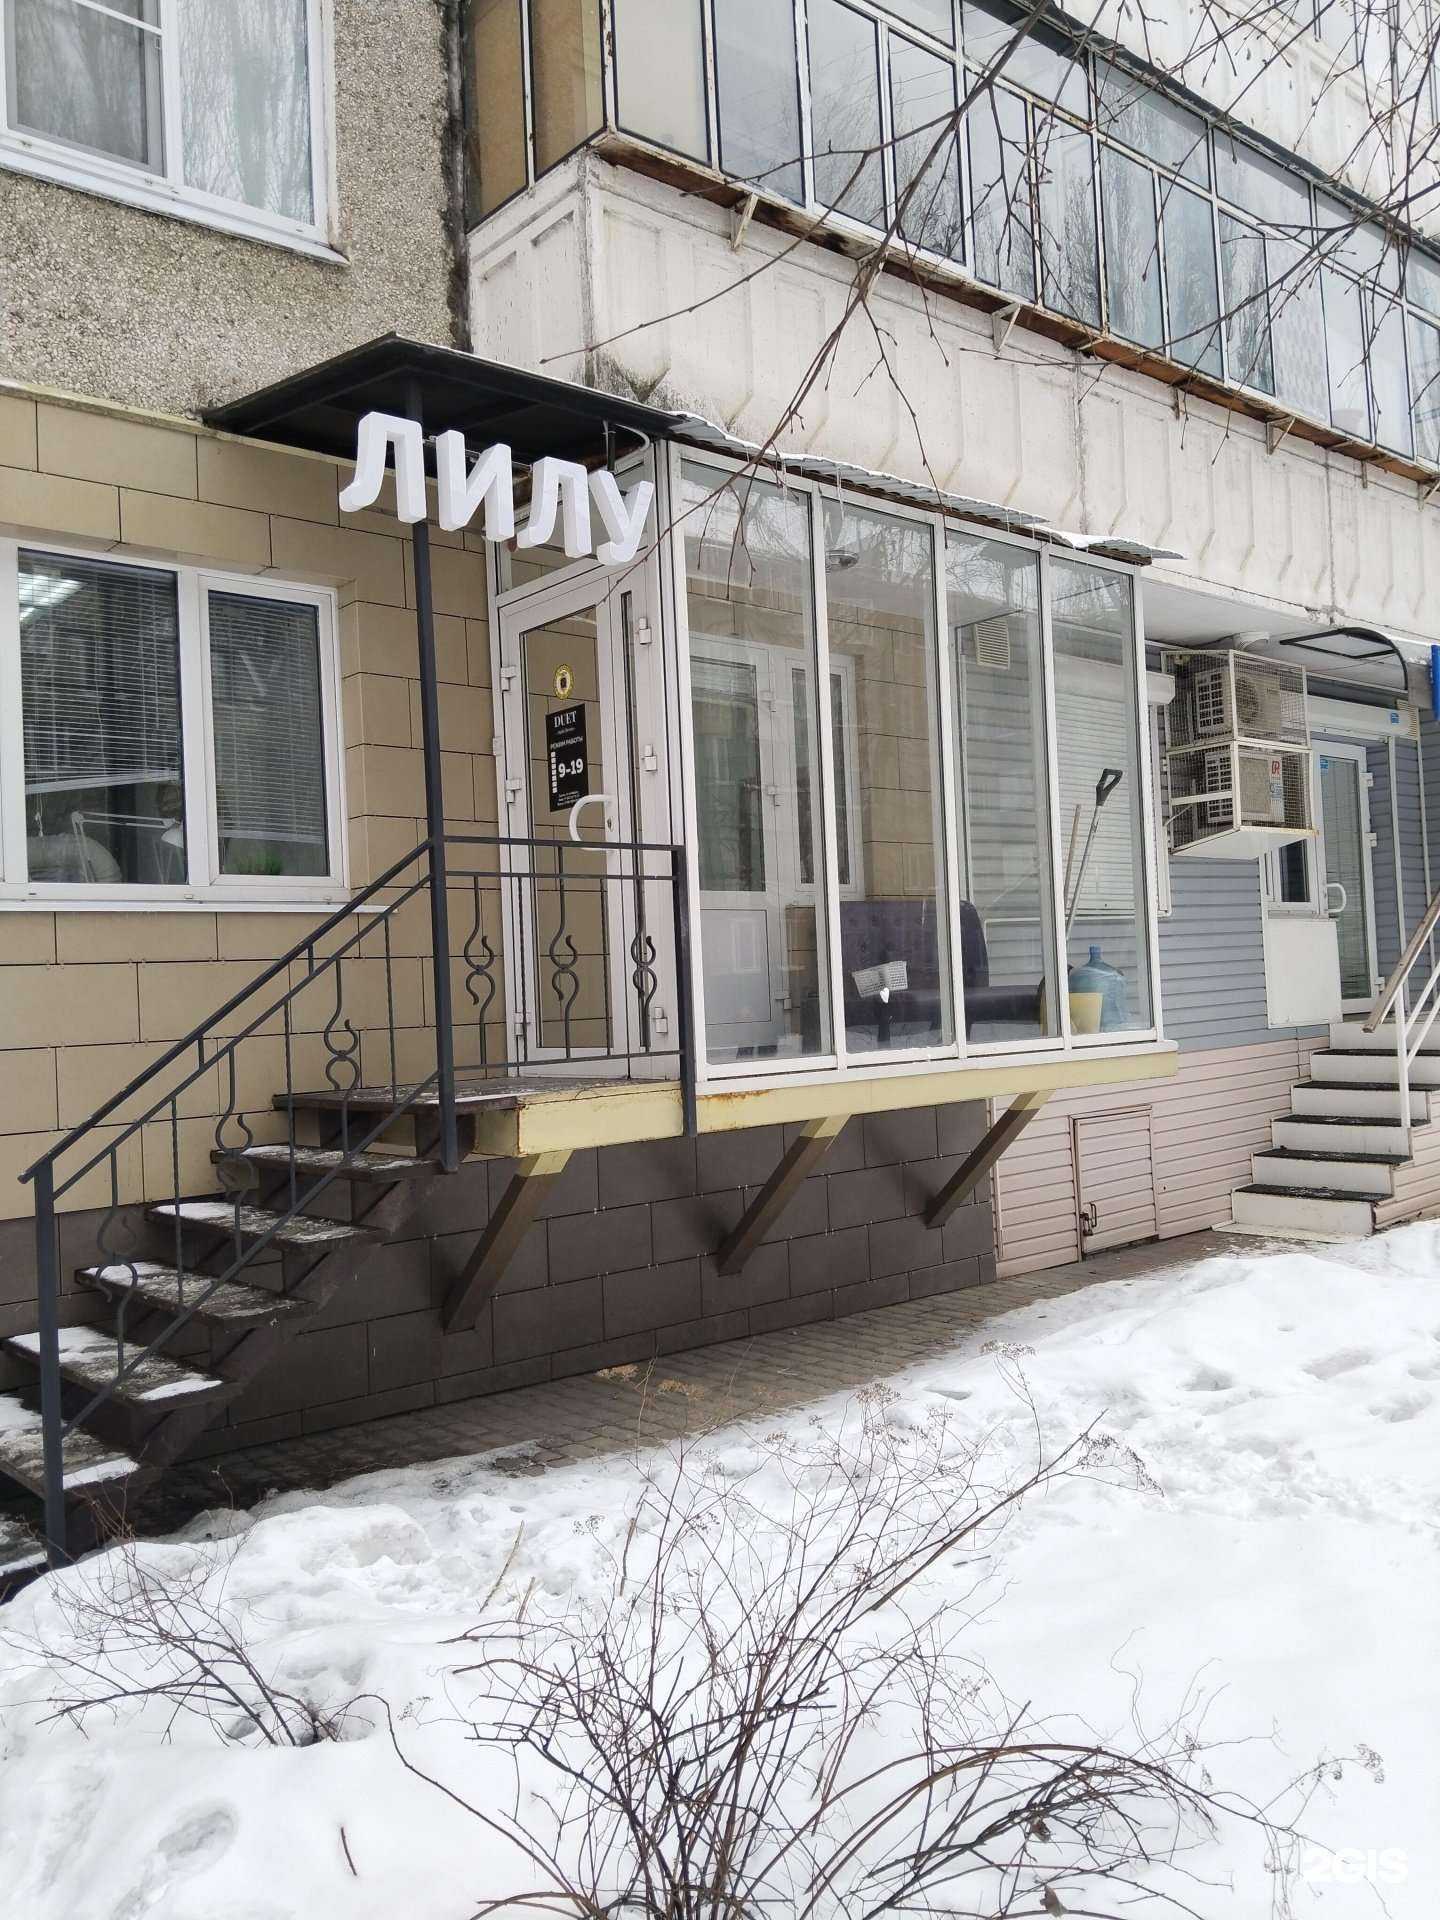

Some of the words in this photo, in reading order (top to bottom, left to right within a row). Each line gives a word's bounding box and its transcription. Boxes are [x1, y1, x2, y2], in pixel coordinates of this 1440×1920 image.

[339, 411, 655, 566] ЛИЛУ
[554, 711, 577, 728] DUET
[558, 758, 583, 778] 9-19
